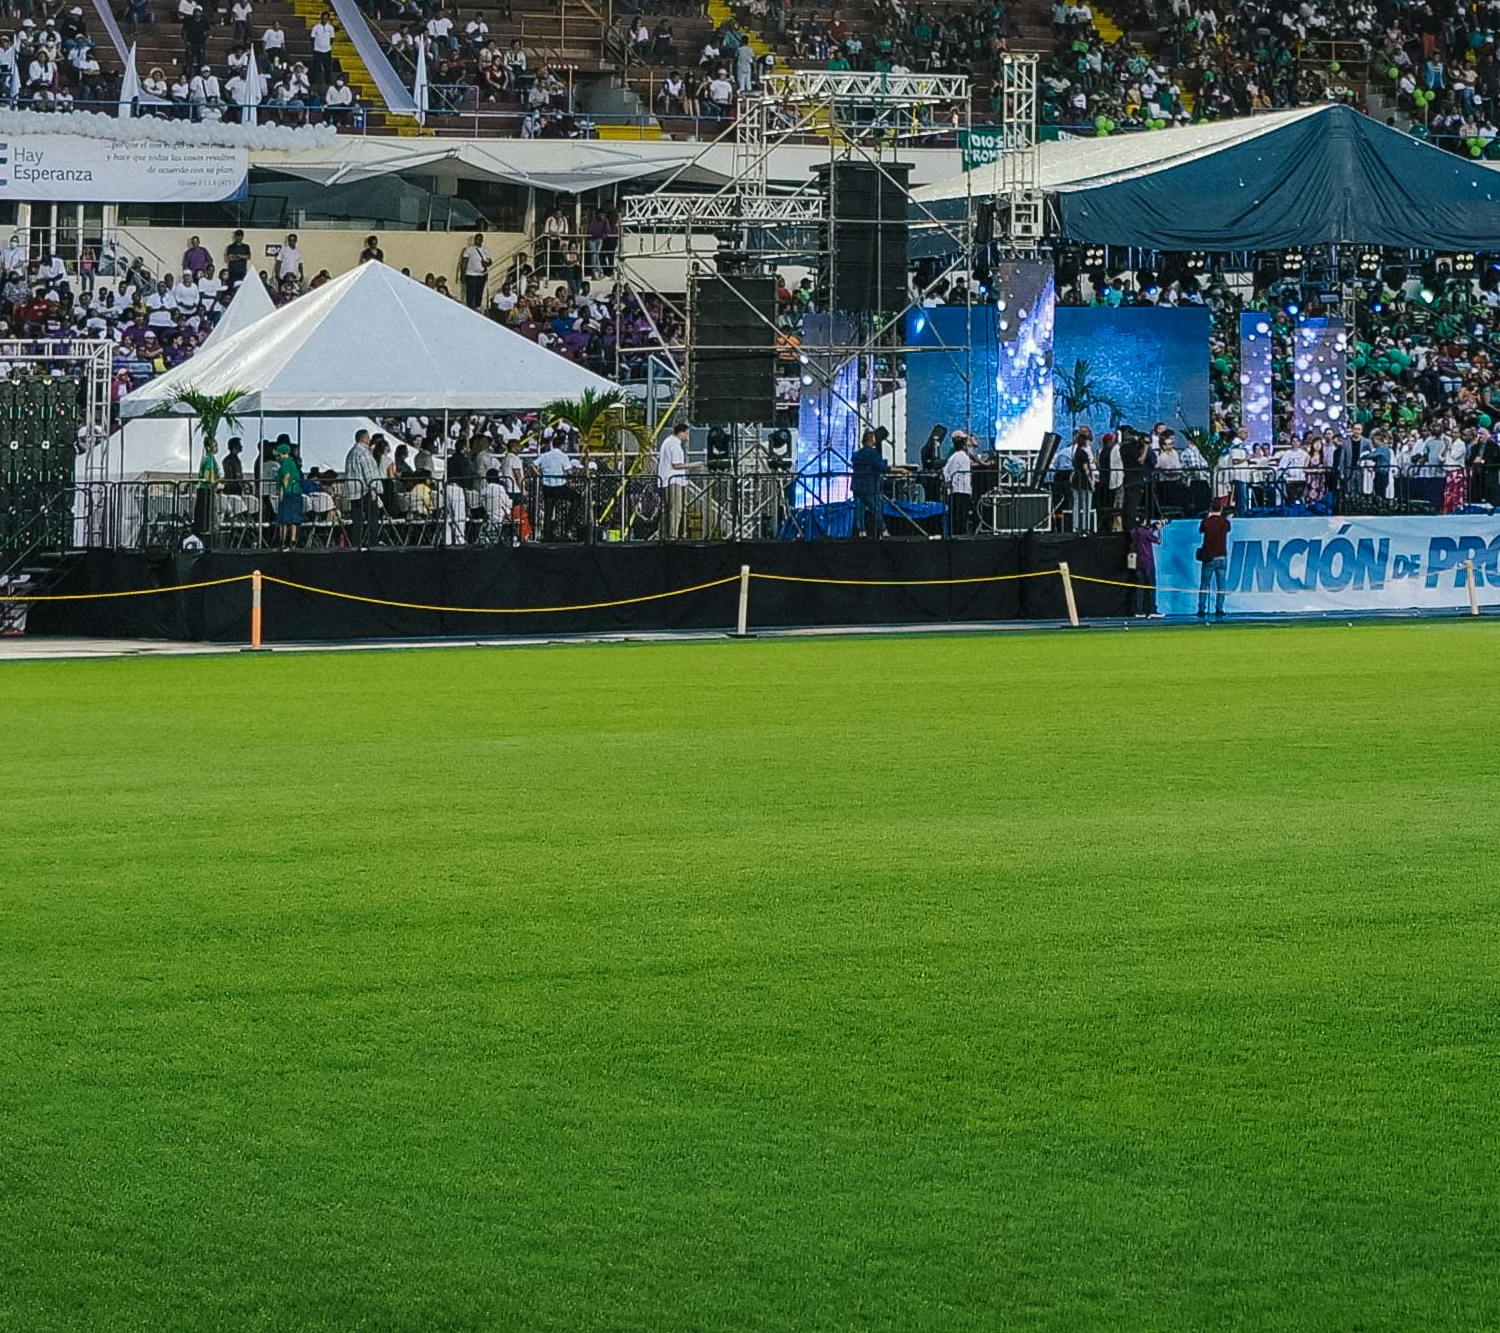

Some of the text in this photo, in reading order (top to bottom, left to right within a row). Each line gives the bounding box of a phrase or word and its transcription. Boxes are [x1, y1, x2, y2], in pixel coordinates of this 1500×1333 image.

[971, 134, 1004, 148] DIOS
[14, 146, 45, 166] Hay
[148, 153, 169, 162] todas
[14, 164, 93, 183] Esperanza
[1392, 553, 1422, 580] DE
